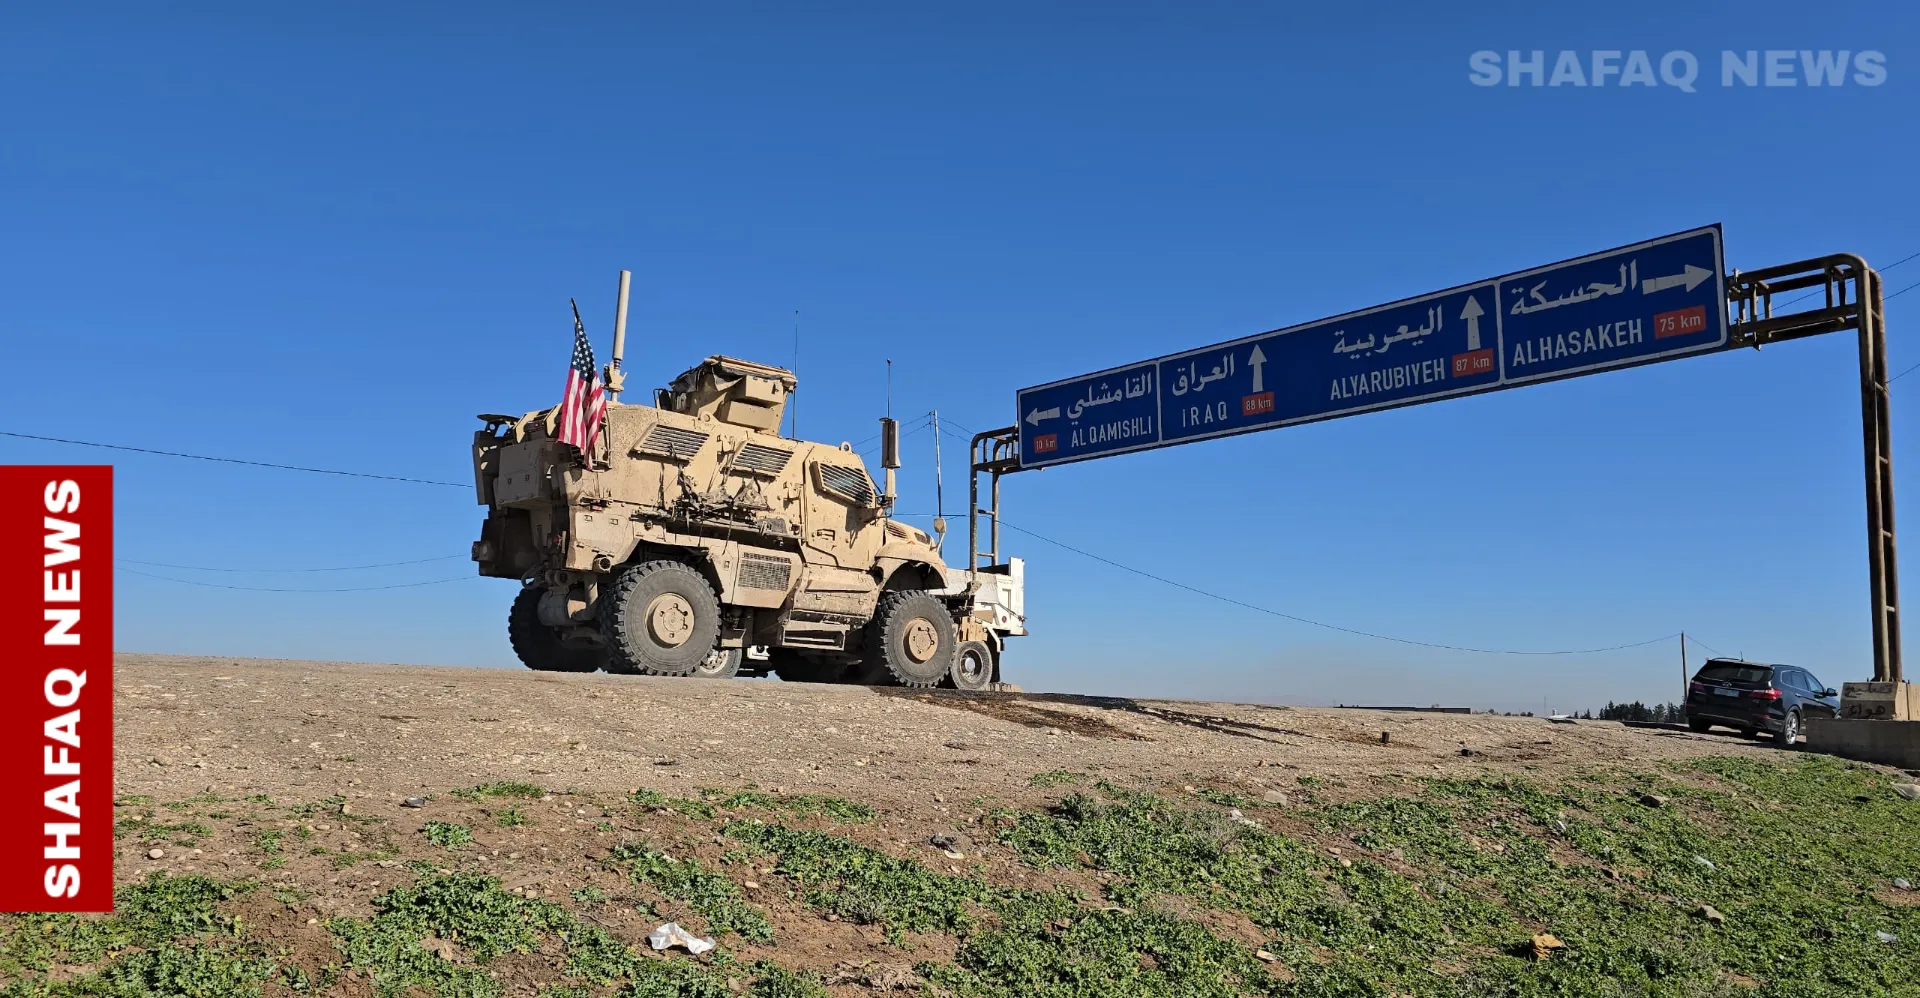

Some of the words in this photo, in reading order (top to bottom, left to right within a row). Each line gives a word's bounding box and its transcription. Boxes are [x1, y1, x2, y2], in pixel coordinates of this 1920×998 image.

[1510, 258, 1637, 315] الحسكة
[1332, 304, 1443, 360] اليعربية
[1512, 318, 1643, 367] ALHASAKEH
[1660, 317, 1675, 332] 75
[1681, 313, 1701, 328] km
[1172, 352, 1235, 397] العراق
[1330, 357, 1446, 401] ALYARUBIYEH
[1456, 358, 1468, 372] 87
[1473, 355, 1490, 369] km
[1067, 371, 1152, 426] القامشلي
[1182, 401, 1228, 428] IRAQ
[1258, 398, 1271, 410] km
[1045, 438, 1056, 449] km
